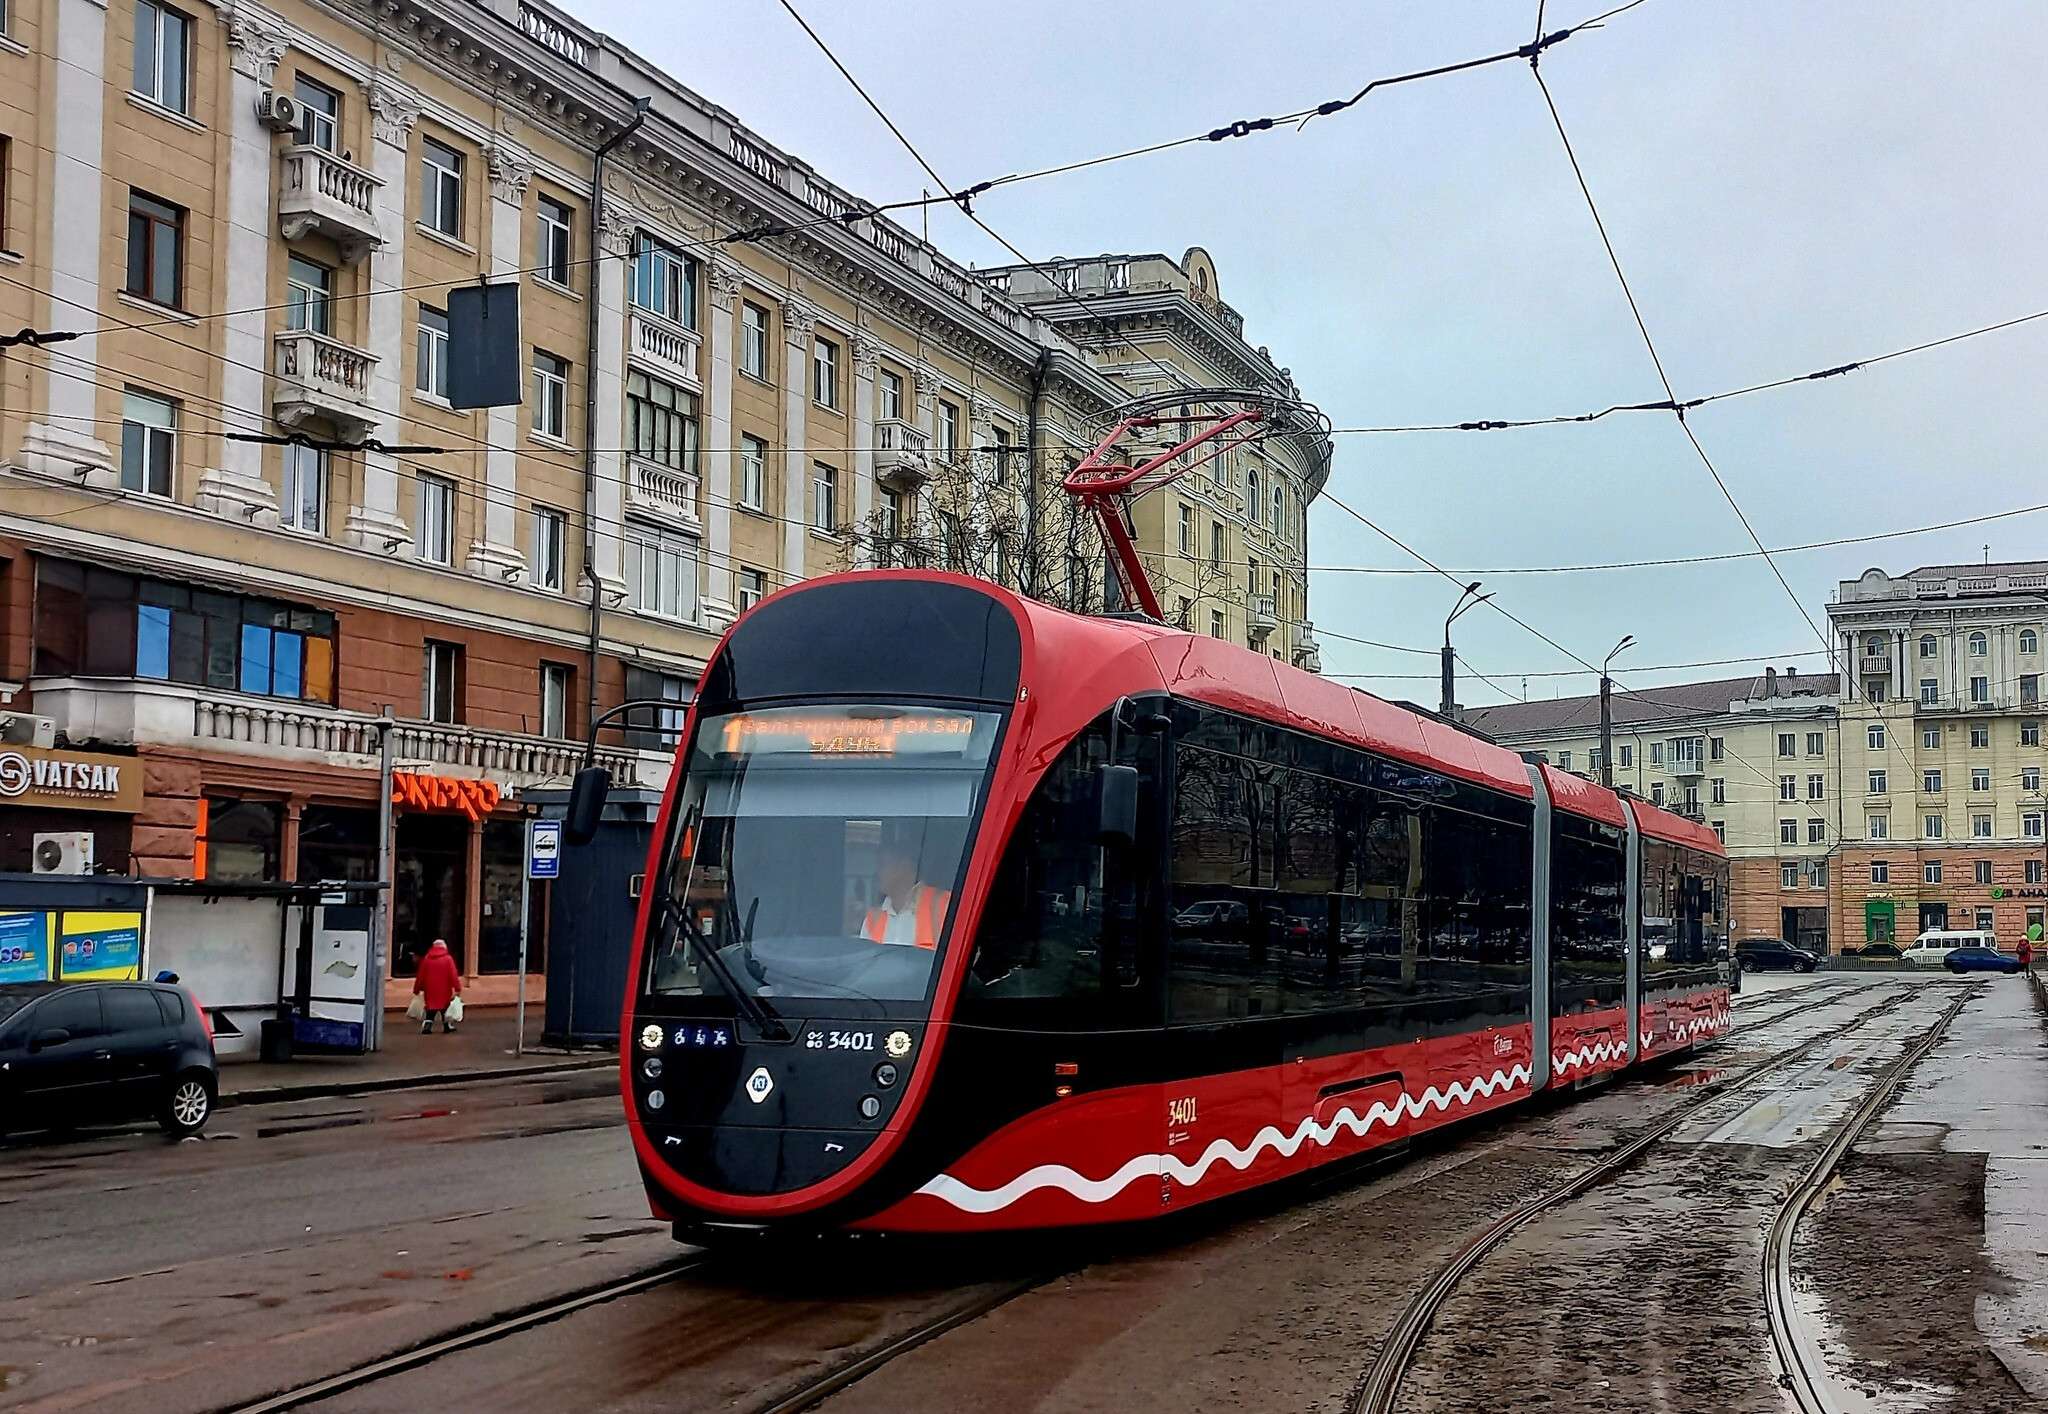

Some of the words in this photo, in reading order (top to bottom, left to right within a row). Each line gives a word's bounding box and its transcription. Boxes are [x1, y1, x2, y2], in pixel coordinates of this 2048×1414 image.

[33, 760, 120, 792] VATSAK
[827, 1031, 875, 1051] 3401
[1168, 1096, 1197, 1128] 3401
